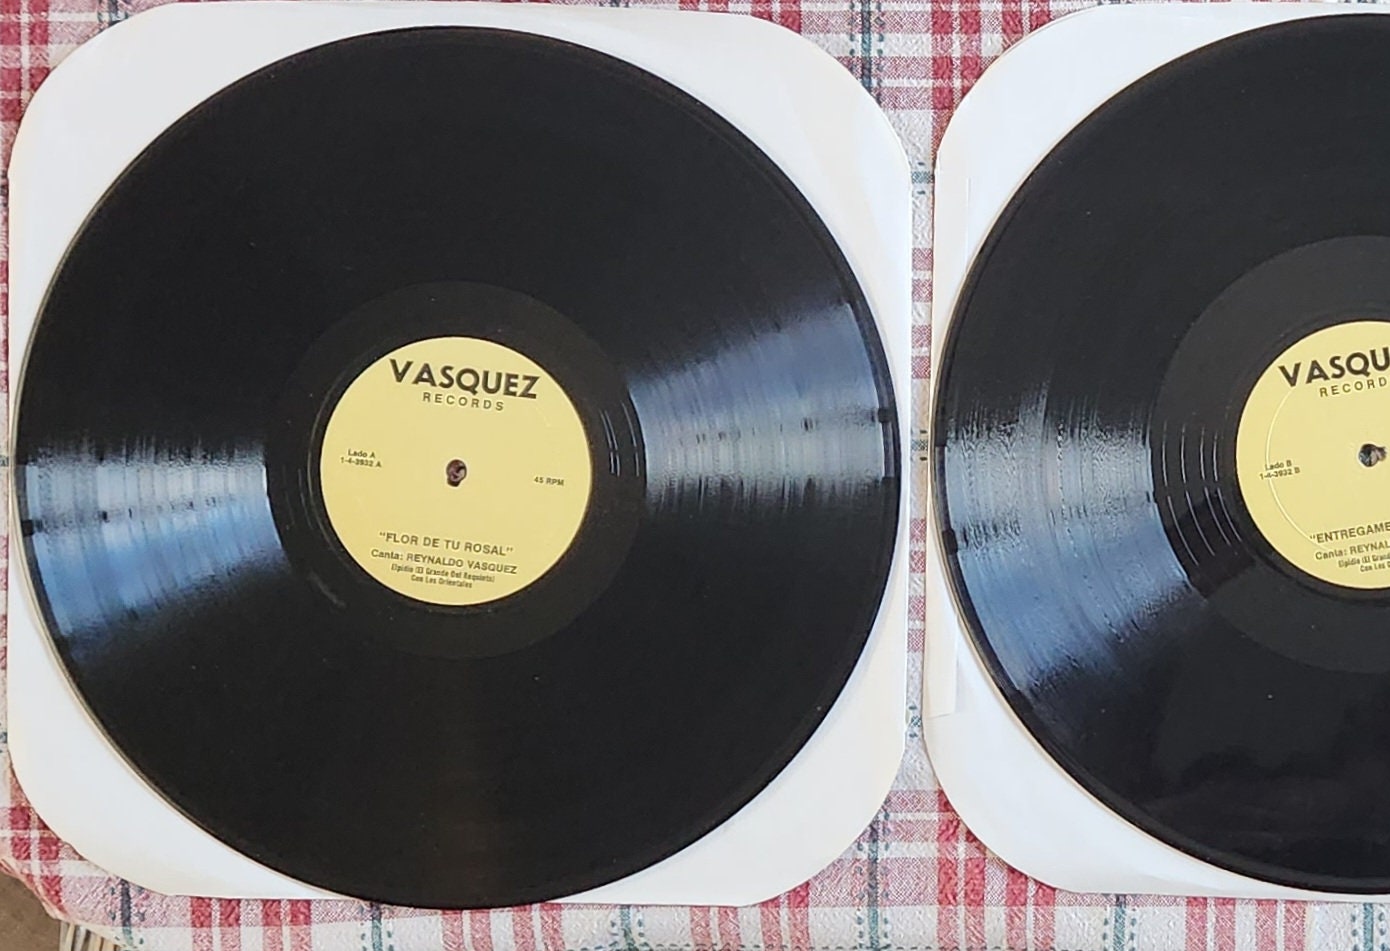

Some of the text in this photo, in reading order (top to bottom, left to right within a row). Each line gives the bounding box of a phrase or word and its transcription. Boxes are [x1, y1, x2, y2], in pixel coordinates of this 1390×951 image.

[389, 358, 540, 399] VASQUEZ
[422, 392, 505, 411] RECORDS
[348, 448, 367, 457] Lado
[1265, 462, 1284, 471] Lado
[546, 478, 564, 486] RPM
[379, 532, 513, 556] "FLOR DE TU ROSAL"
[371, 549, 518, 574] Canta: REYNALDO VASQUEZ
[1315, 549, 1348, 560] Canta:
